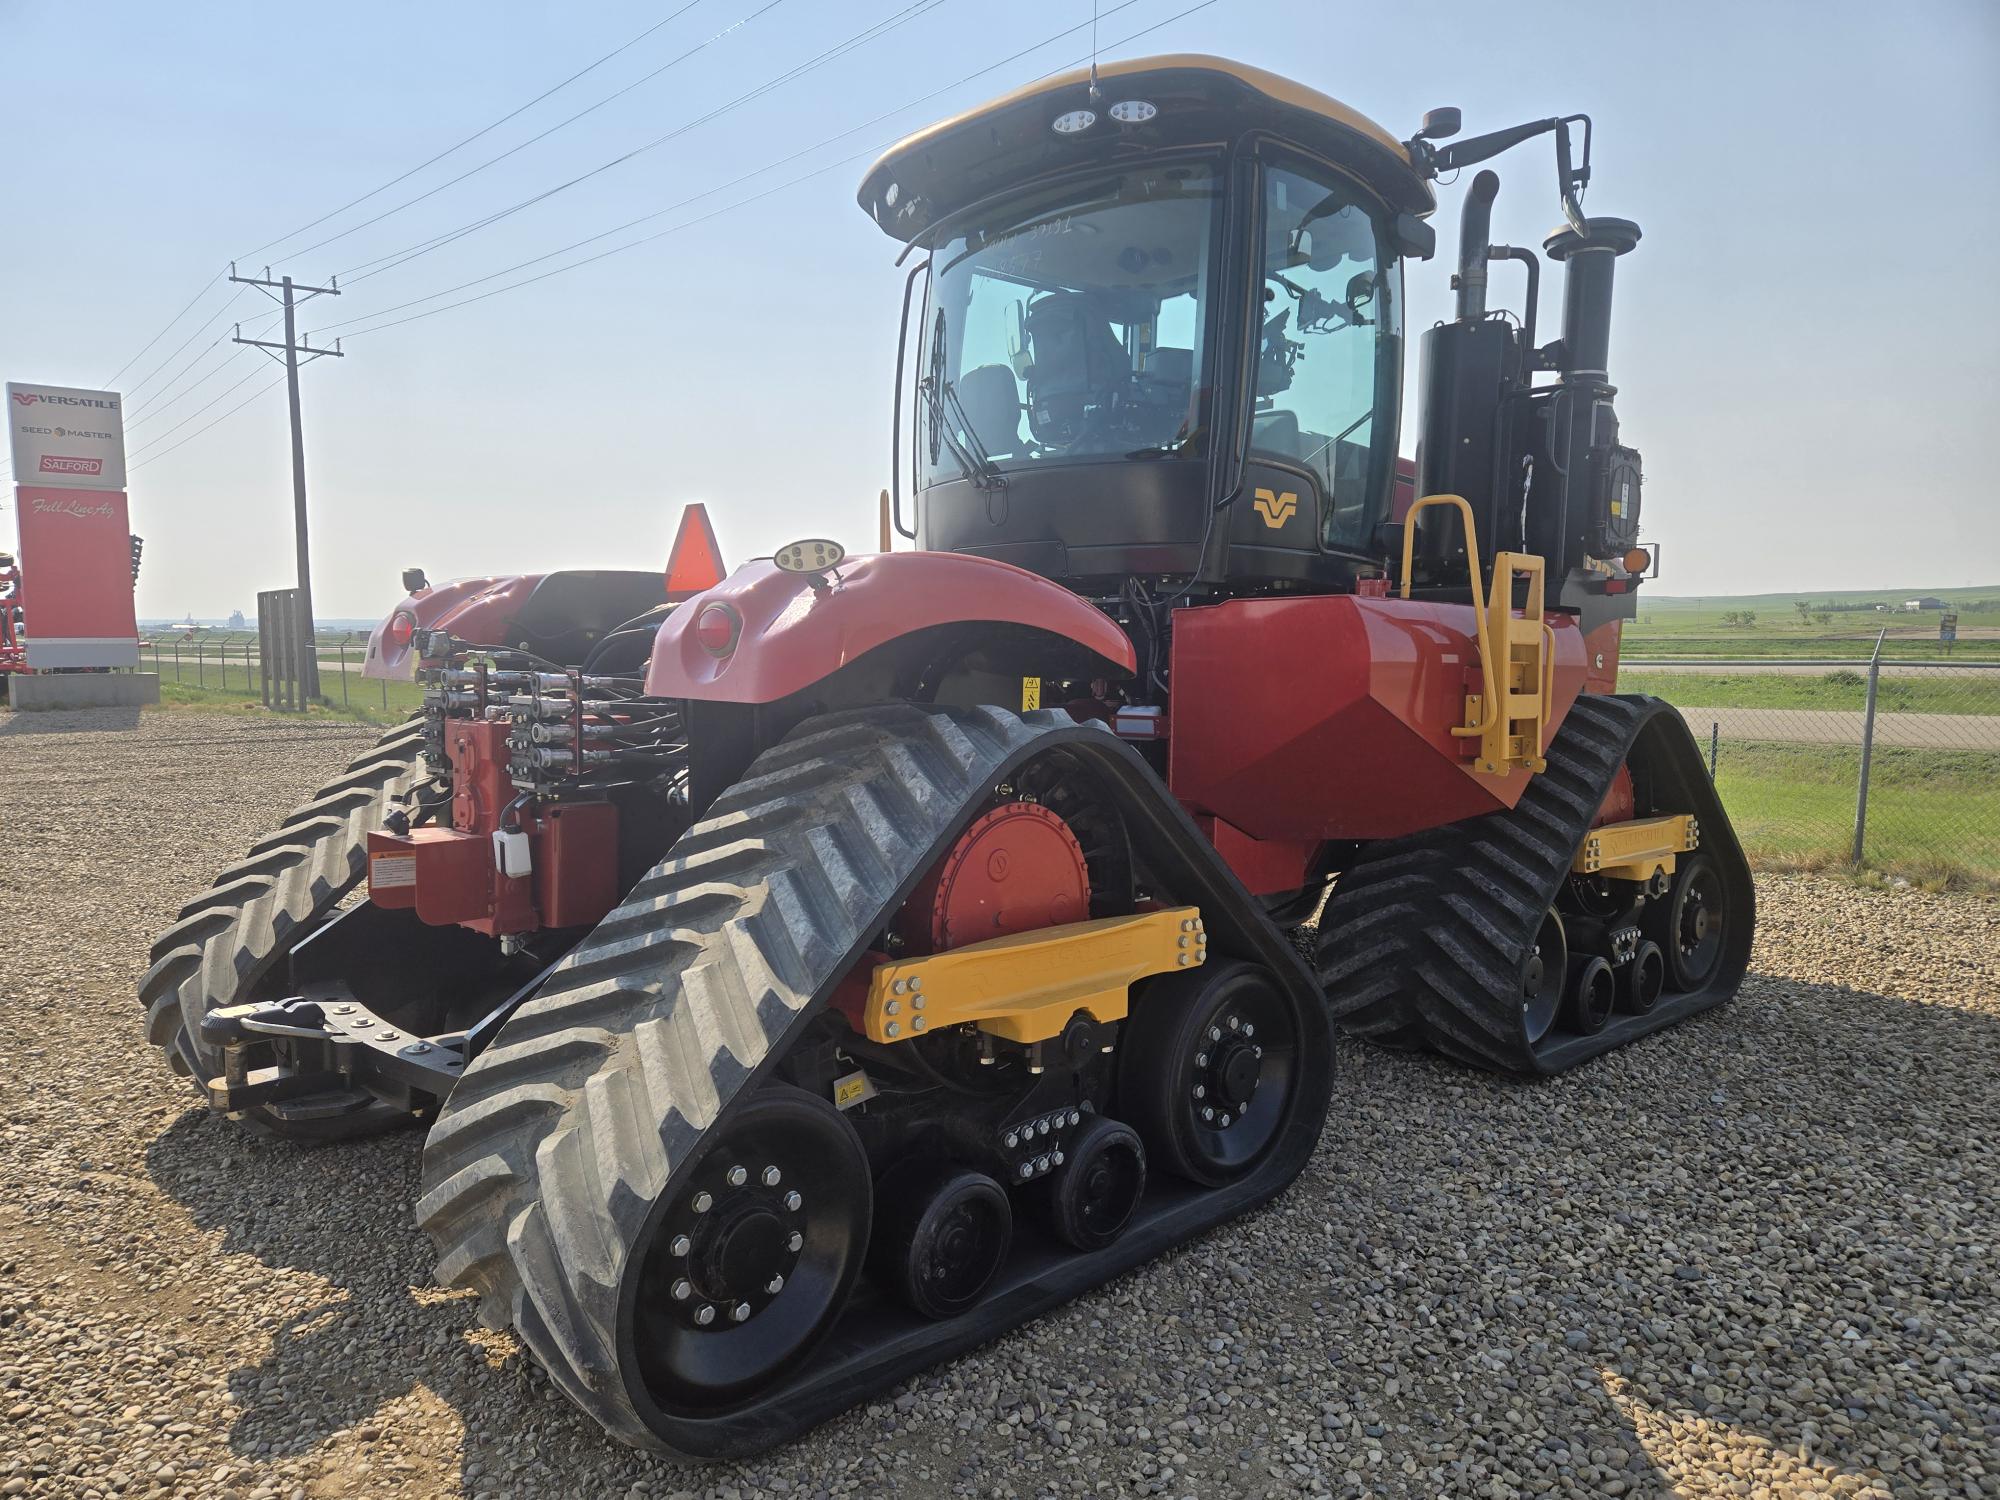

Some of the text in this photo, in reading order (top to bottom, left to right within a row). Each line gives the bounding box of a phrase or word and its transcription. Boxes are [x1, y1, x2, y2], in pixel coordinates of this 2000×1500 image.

[38, 394, 118, 409] VERSATILE
[21, 426, 112, 439] SEED MASTER
[42, 458, 99, 472] SALFORD
[32, 499, 114, 518] Full Line Ag
